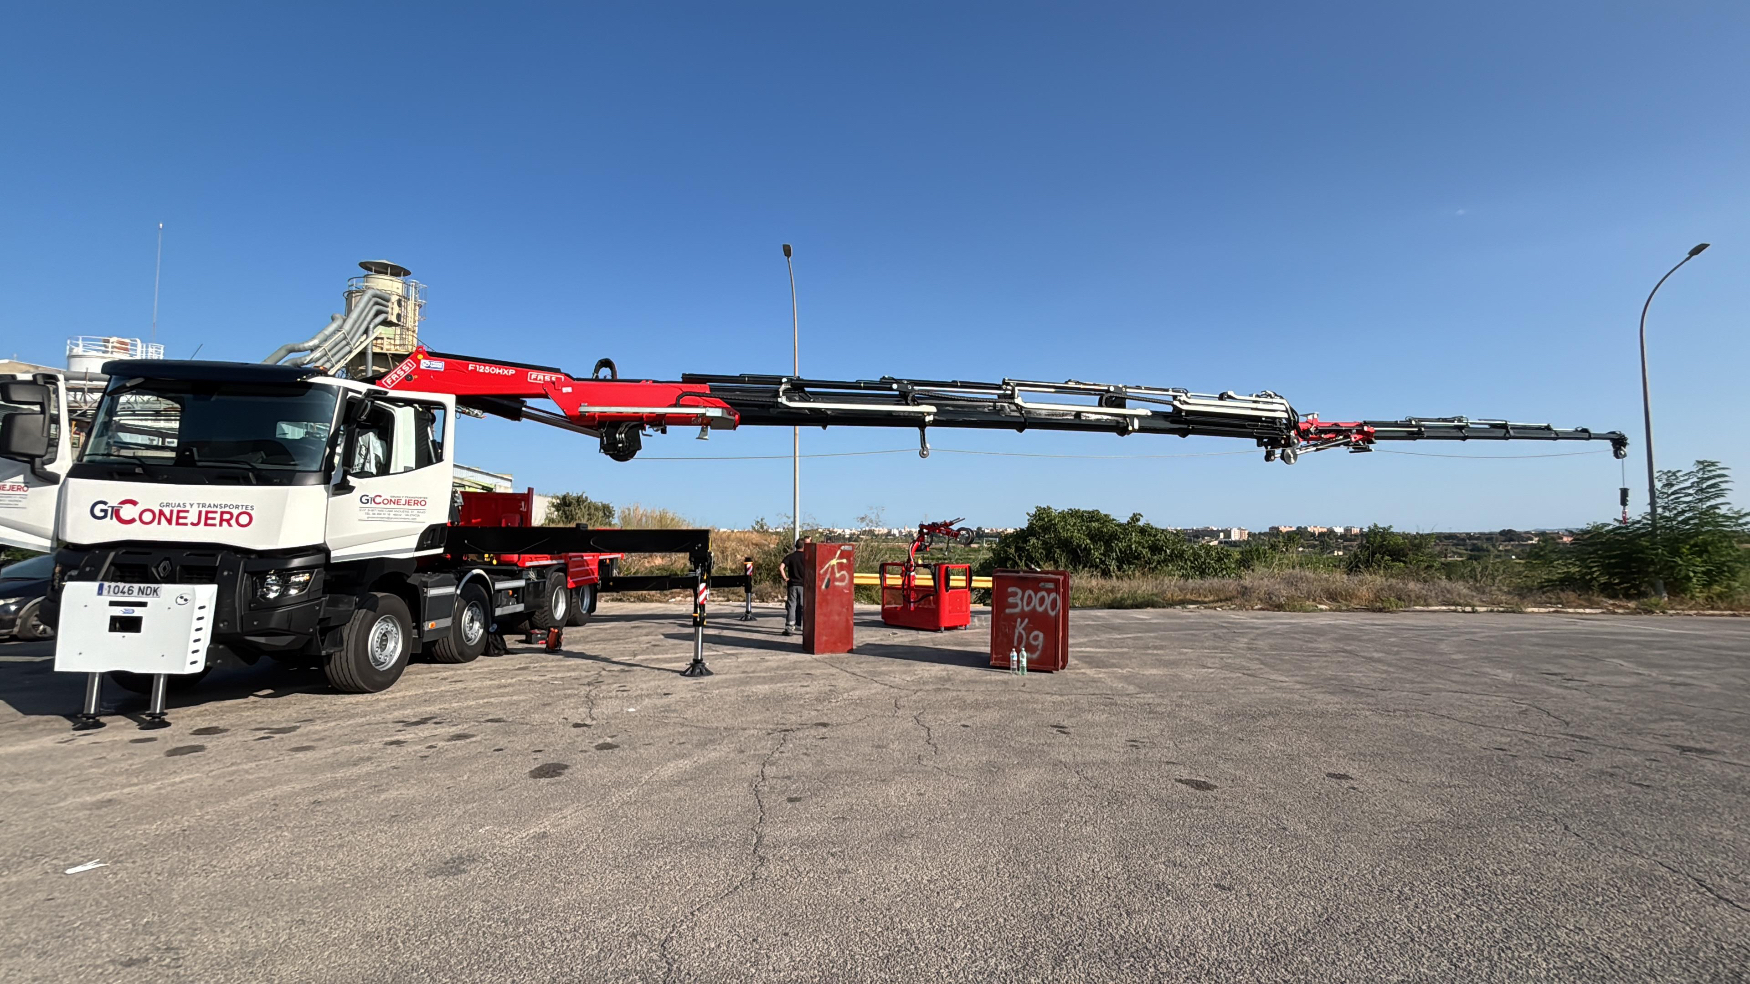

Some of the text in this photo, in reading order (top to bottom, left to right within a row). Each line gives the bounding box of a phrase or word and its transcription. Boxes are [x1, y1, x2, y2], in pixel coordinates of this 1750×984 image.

[386, 362, 413, 385] FASSI
[468, 364, 516, 376] F1250HXP
[530, 373, 559, 382] FASS
[196, 502, 255, 511] TRANSPORTES
[107, 585, 160, 596] 1046 NDK
[1005, 587, 1060, 617] 3000
